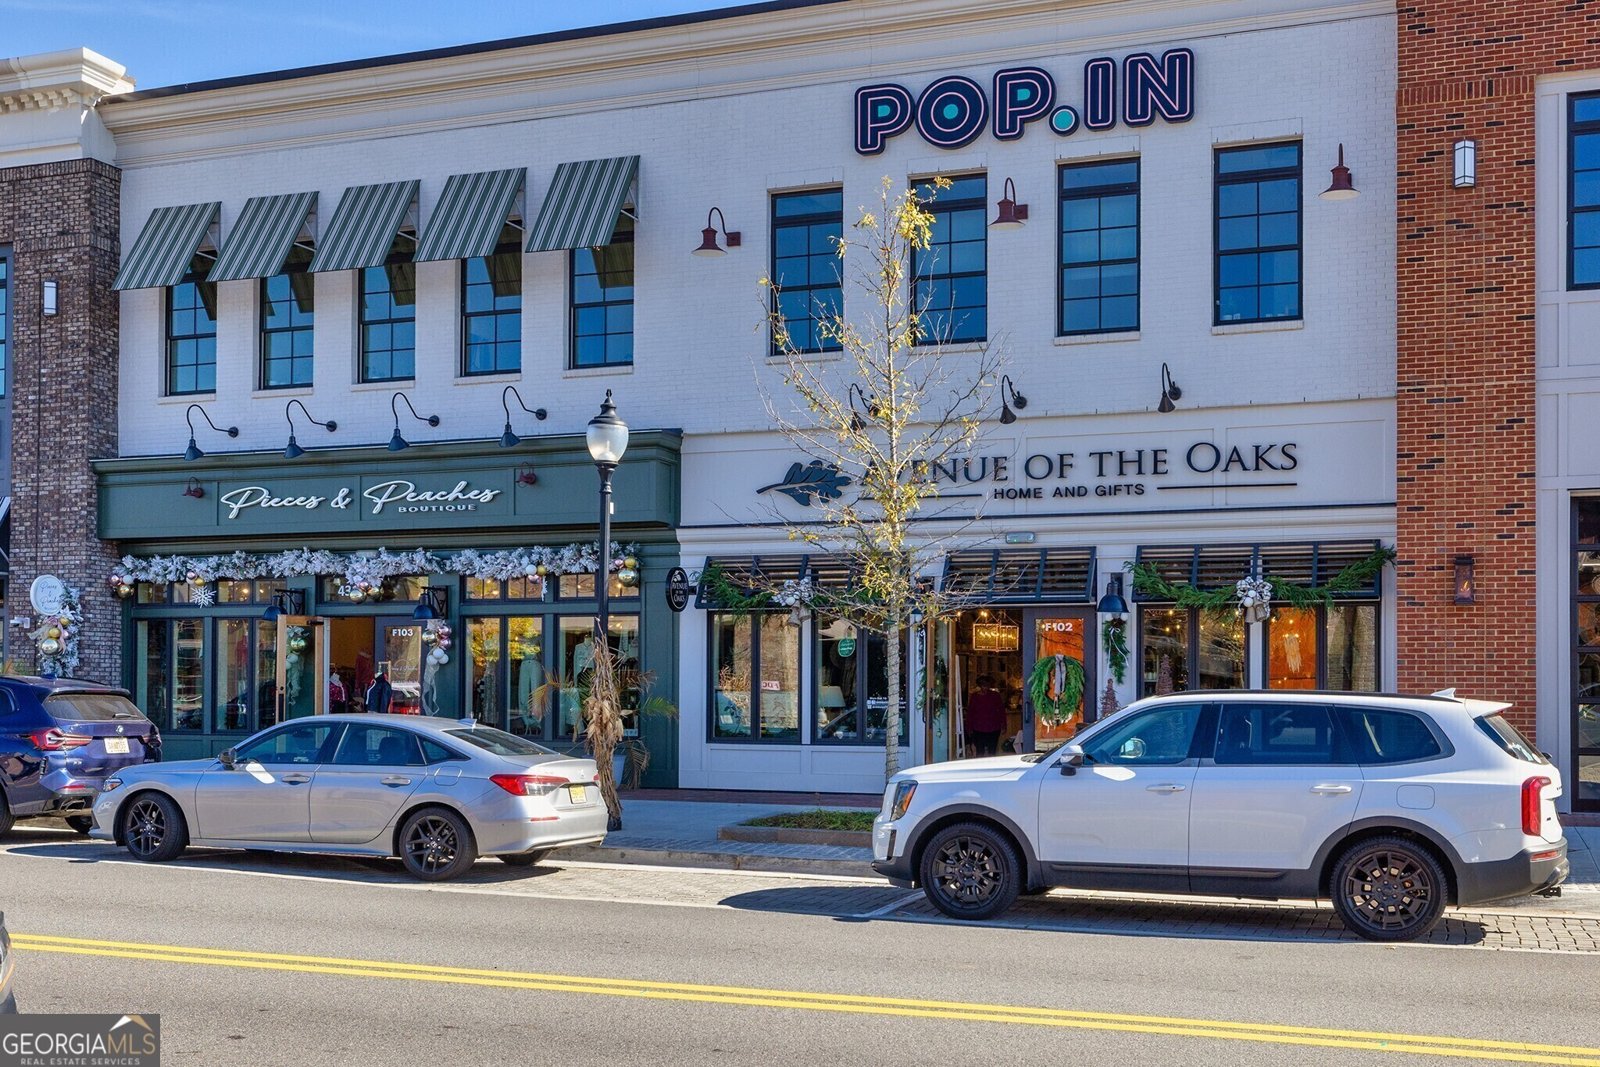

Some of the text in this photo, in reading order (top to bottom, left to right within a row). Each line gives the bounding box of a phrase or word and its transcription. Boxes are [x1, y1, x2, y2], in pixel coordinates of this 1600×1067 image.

[854, 48, 1194, 156] POP.IN
[1024, 453, 1075, 480] OF
[1088, 449, 1169, 477] THE
[1186, 442, 1298, 473] OAKS
[220, 480, 501, 519] Pieces & Peaches
[993, 483, 1145, 500] HOME AND GIFTS
[398, 503, 476, 513] BOUTIQUE
[392, 628, 413, 637] F103
[1045, 622, 1073, 631] F102
